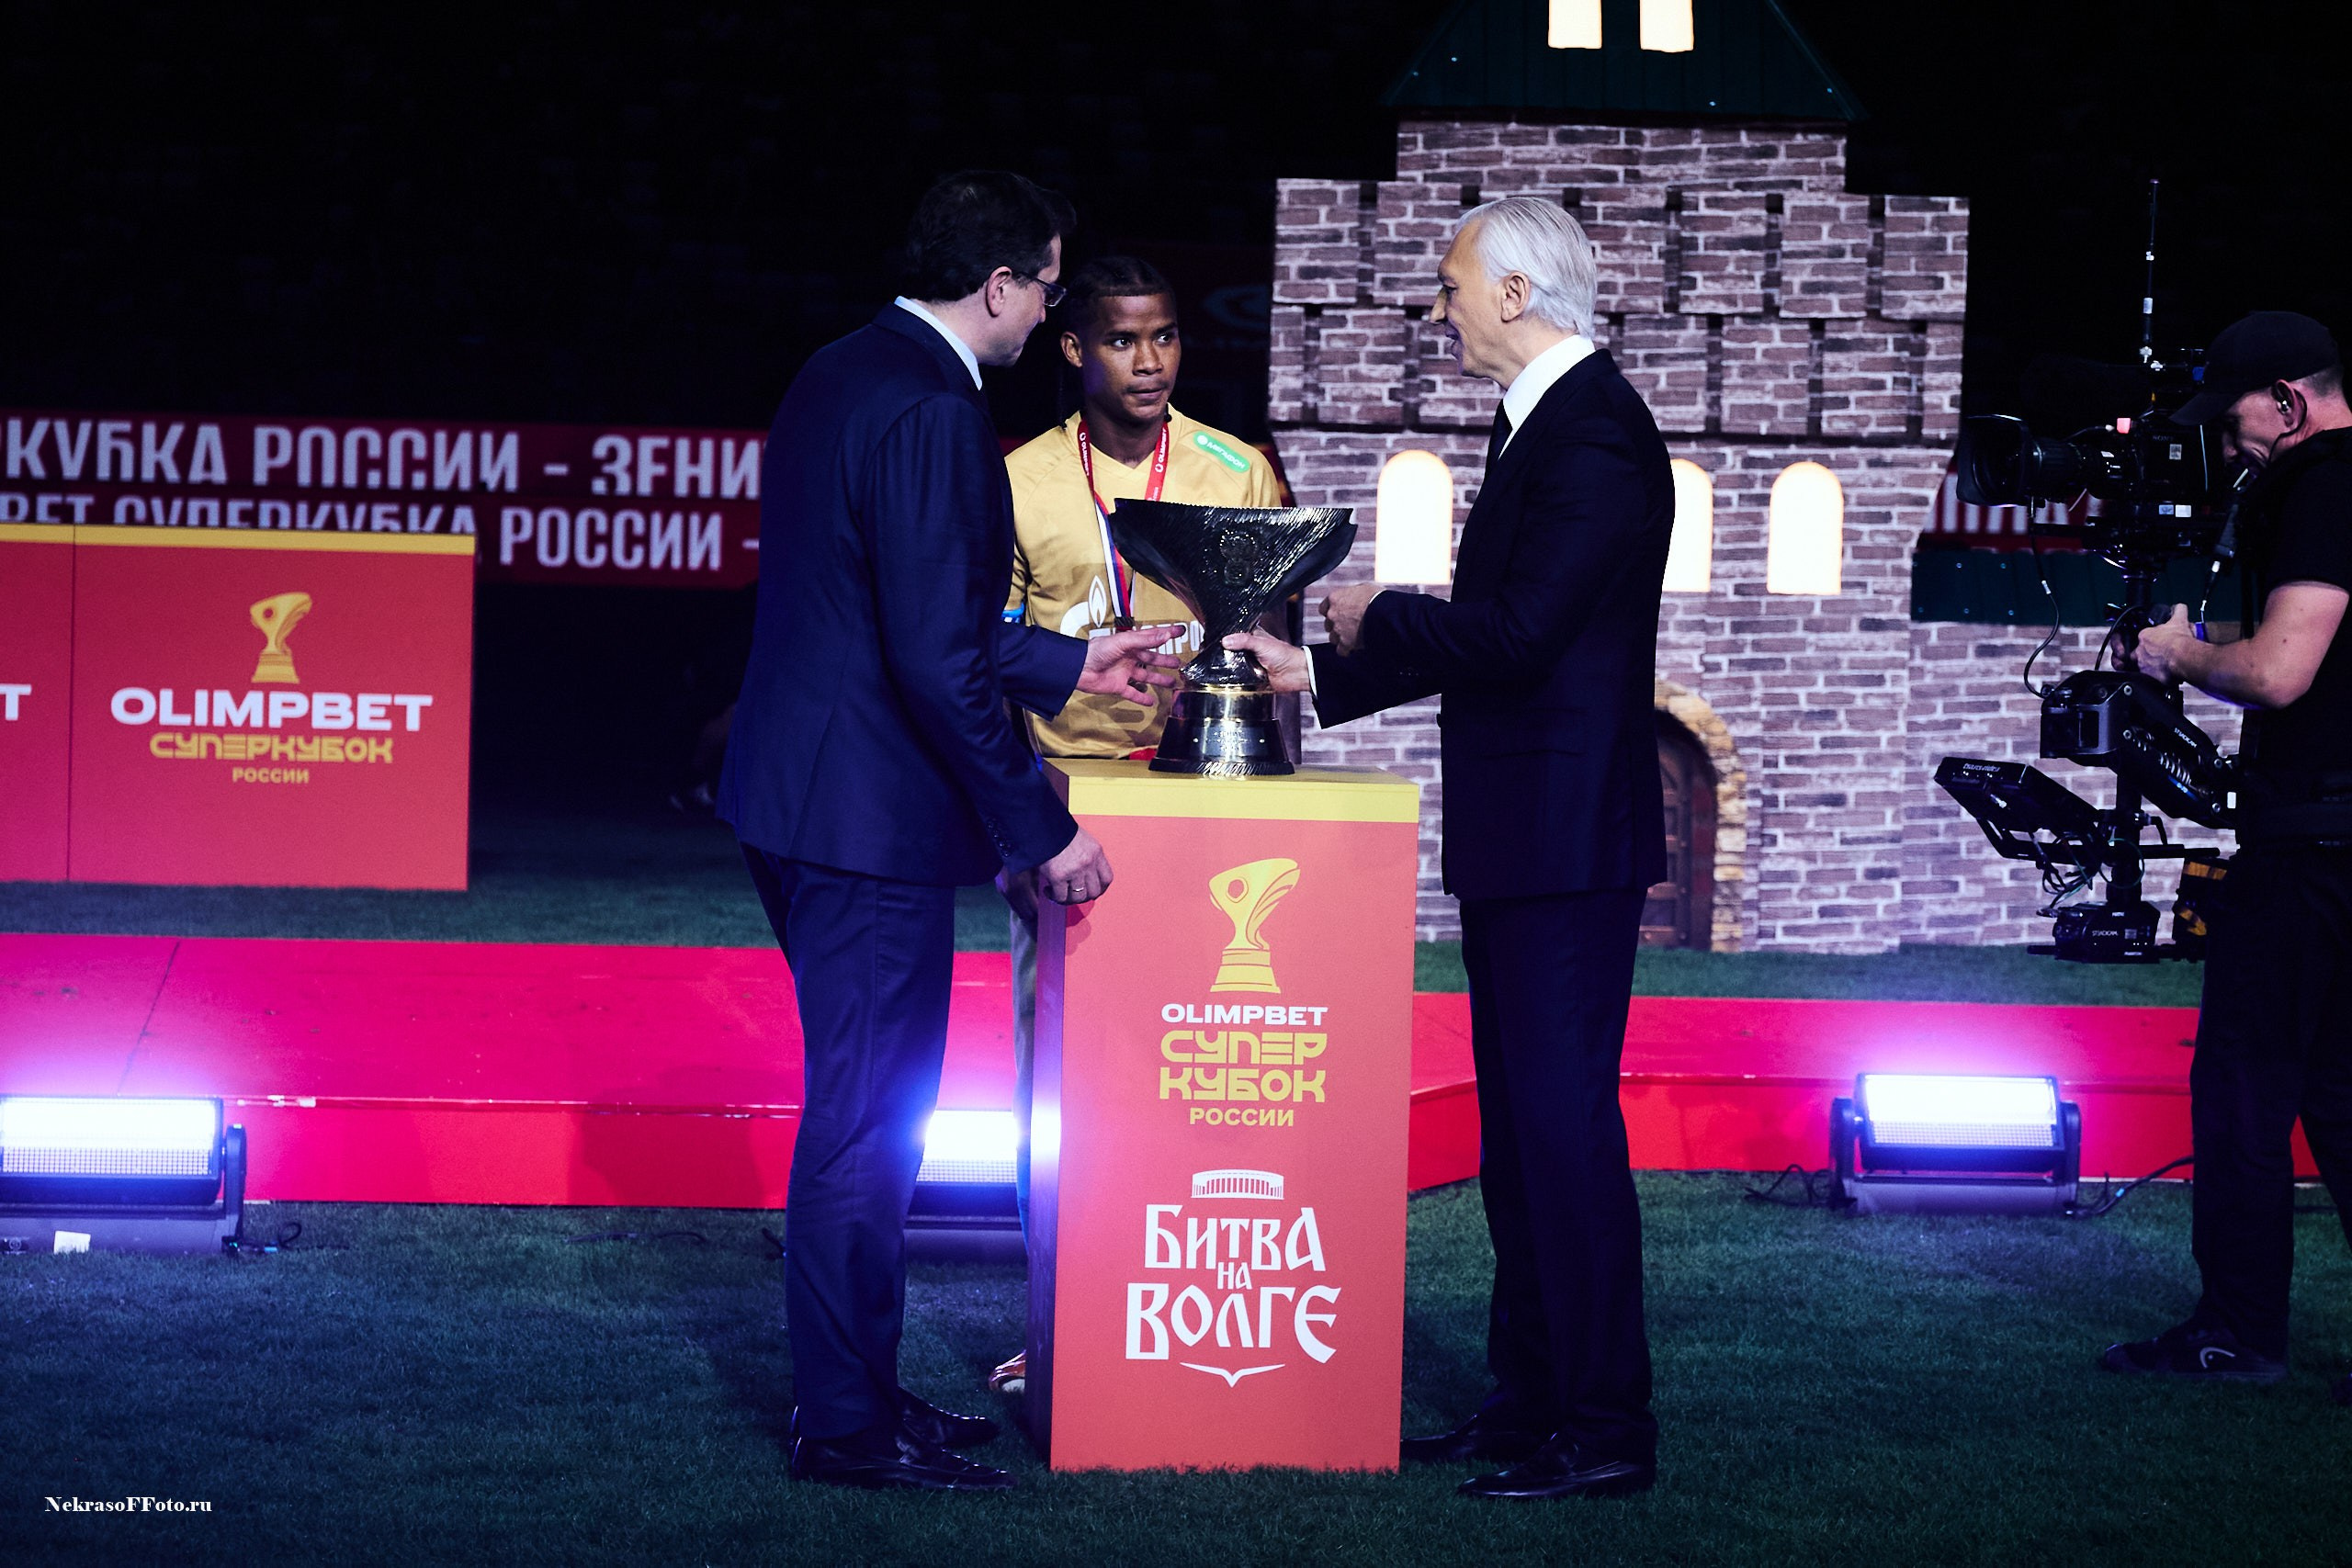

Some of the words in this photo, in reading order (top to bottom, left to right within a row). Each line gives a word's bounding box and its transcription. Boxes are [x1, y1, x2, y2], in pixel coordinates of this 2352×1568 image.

[0, 416, 228, 485] КУБКА
[253, 423, 520, 493] РОССИИ
[590, 434, 767, 501] ЗЕНИ
[500, 505, 722, 571] РОССИИ
[110, 687, 434, 731] OLIMPBET
[150, 732, 394, 763] СУПЕРКУБОК
[232, 768, 310, 784] РОССИИ
[1160, 1003, 1329, 1027] OLIMPBET
[1160, 1030, 1328, 1066] СУПЕР
[1159, 1066, 1326, 1102] КУБОК
[1189, 1107, 1295, 1127] РОССИИ
[1145, 1204, 1327, 1272] БИТВА
[1125, 1282, 1342, 1364] ВОЛГЕ
